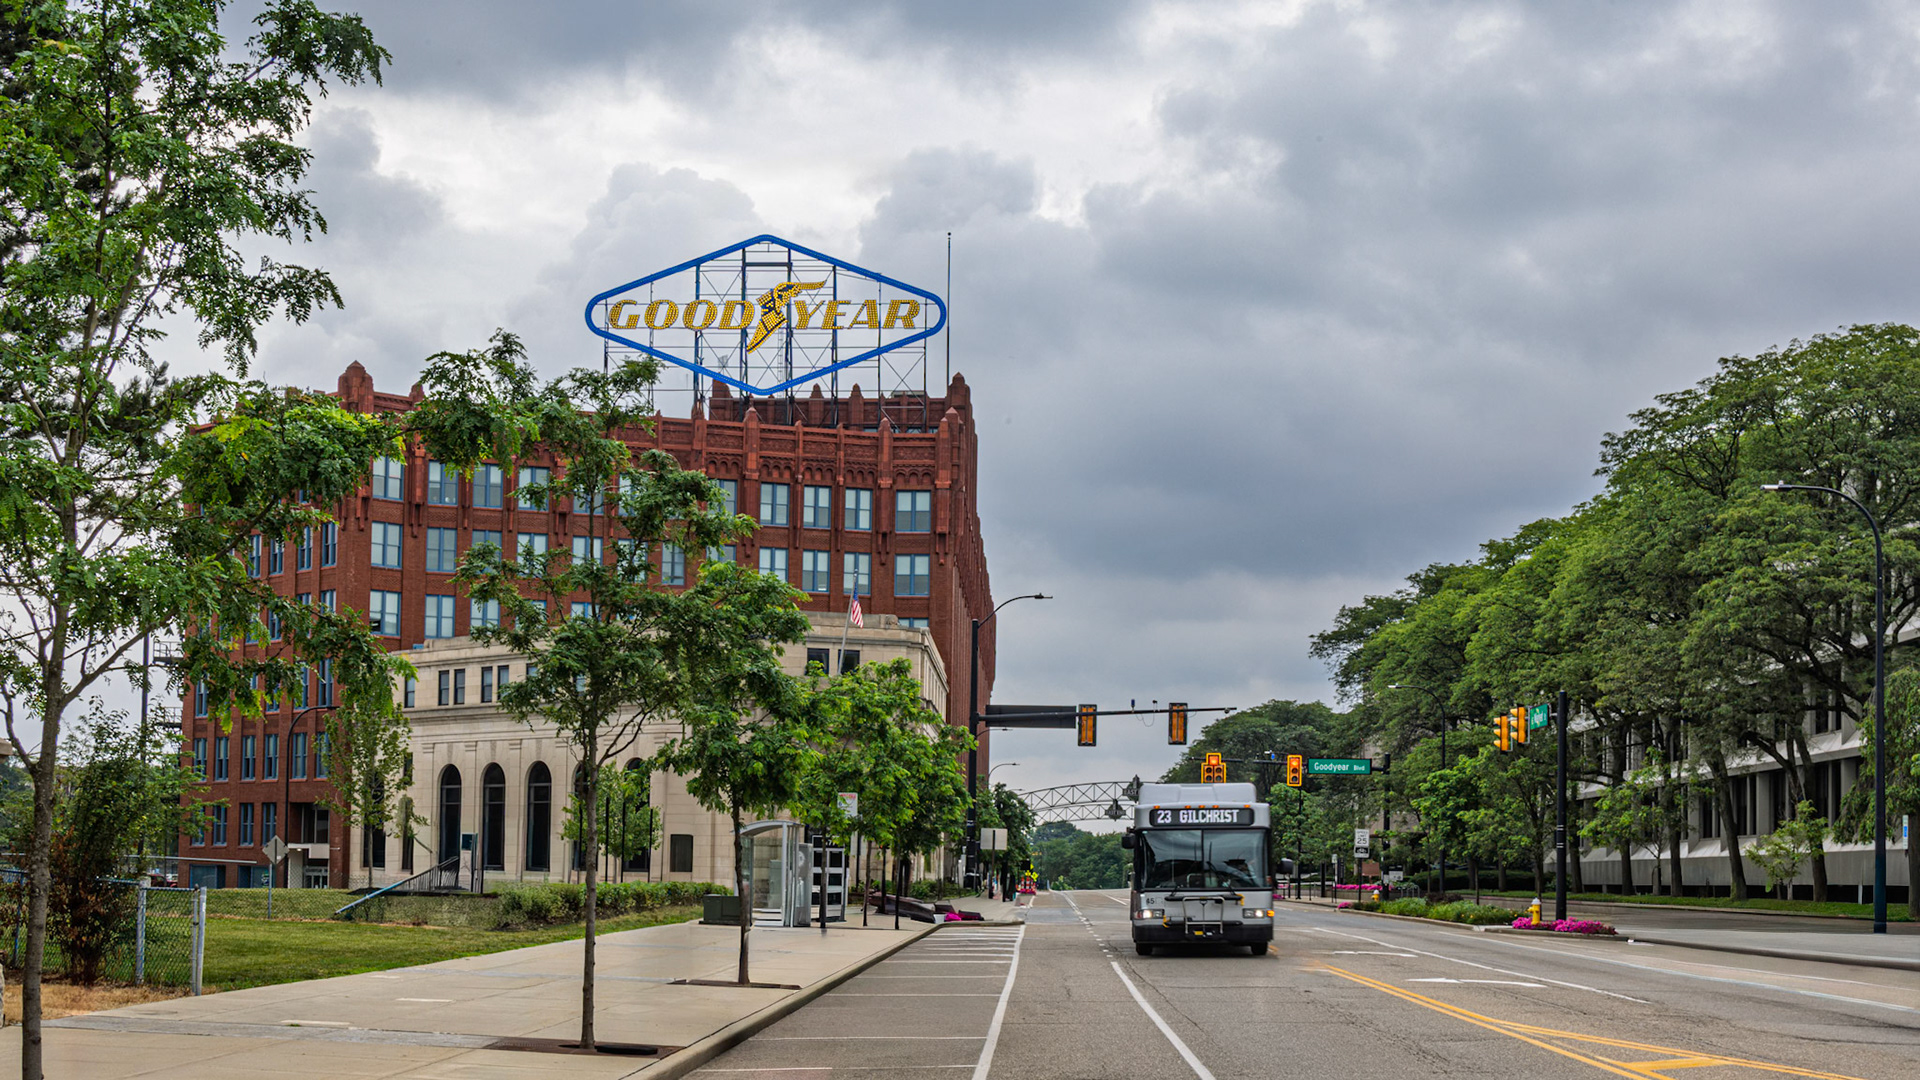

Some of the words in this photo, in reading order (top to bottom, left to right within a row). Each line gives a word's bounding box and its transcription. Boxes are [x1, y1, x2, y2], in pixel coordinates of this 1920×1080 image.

[1314, 762, 1349, 773] Goodyear
[1157, 810, 1172, 823] 23
[1180, 809, 1239, 823] GILCHRIST
